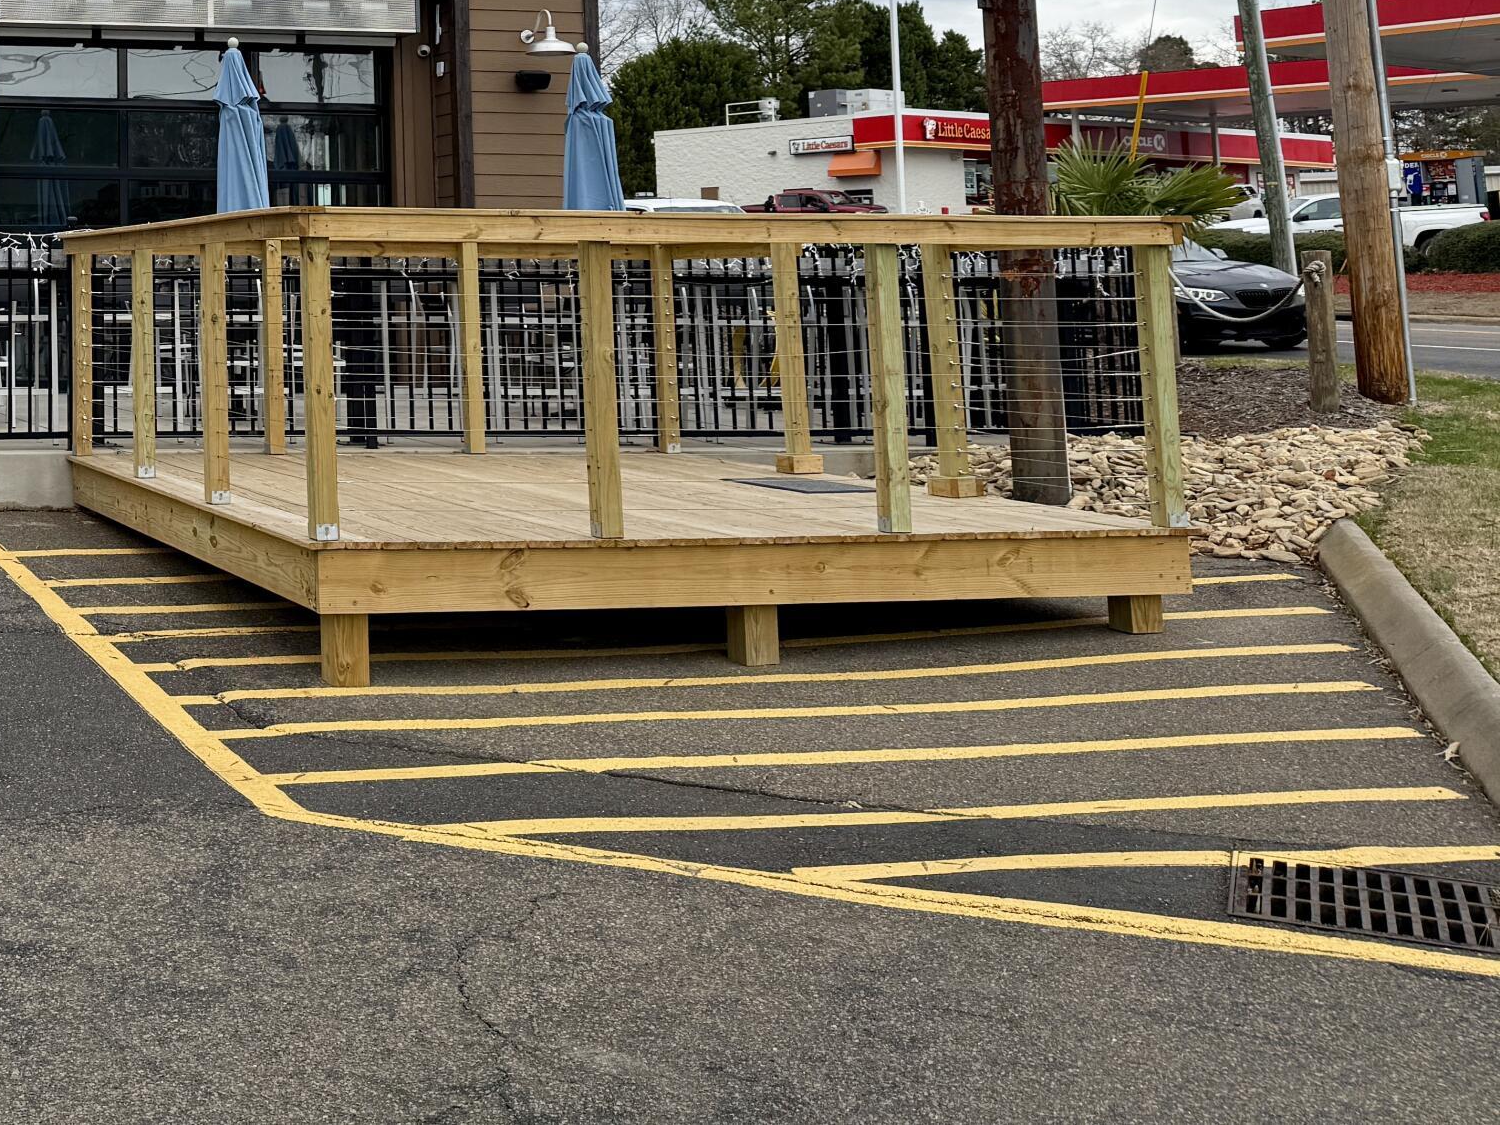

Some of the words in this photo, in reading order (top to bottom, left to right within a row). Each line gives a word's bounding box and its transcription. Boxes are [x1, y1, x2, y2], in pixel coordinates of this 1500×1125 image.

[937, 122, 963, 138] Little
[963, 123, 991, 139] Caesa
[802, 142, 820, 151] Little
[820, 140, 849, 150] Caesars
[1125, 135, 1153, 147] CCLE
[1154, 134, 1165, 151] K
